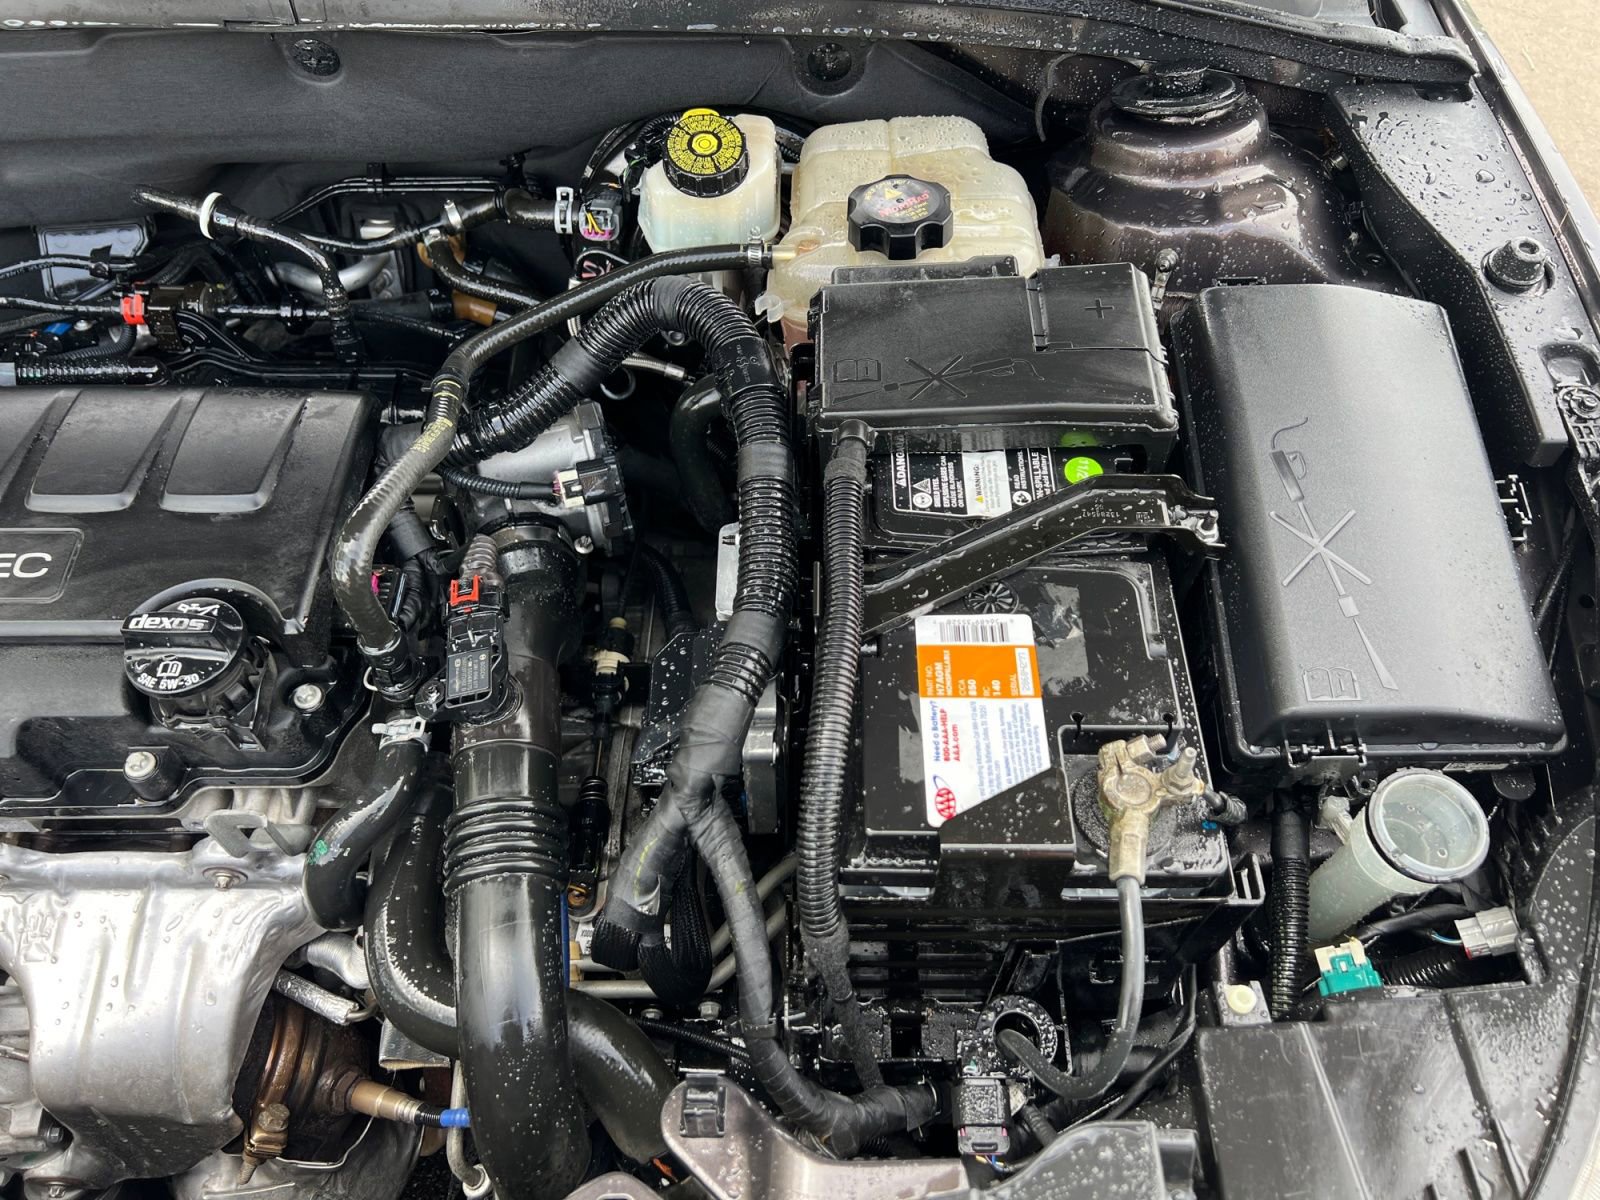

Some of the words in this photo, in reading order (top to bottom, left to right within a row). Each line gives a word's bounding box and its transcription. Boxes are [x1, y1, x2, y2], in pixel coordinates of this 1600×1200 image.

[128, 614, 209, 630] dexos
[138, 672, 158, 688] SAE
[159, 673, 200, 690] 5W-30
[1009, 674, 1018, 696] SERIAL
[930, 700, 939, 731] Battery?
[940, 708, 950, 762] 800-AAA-HELP
[952, 724, 960, 762] AAA.com
